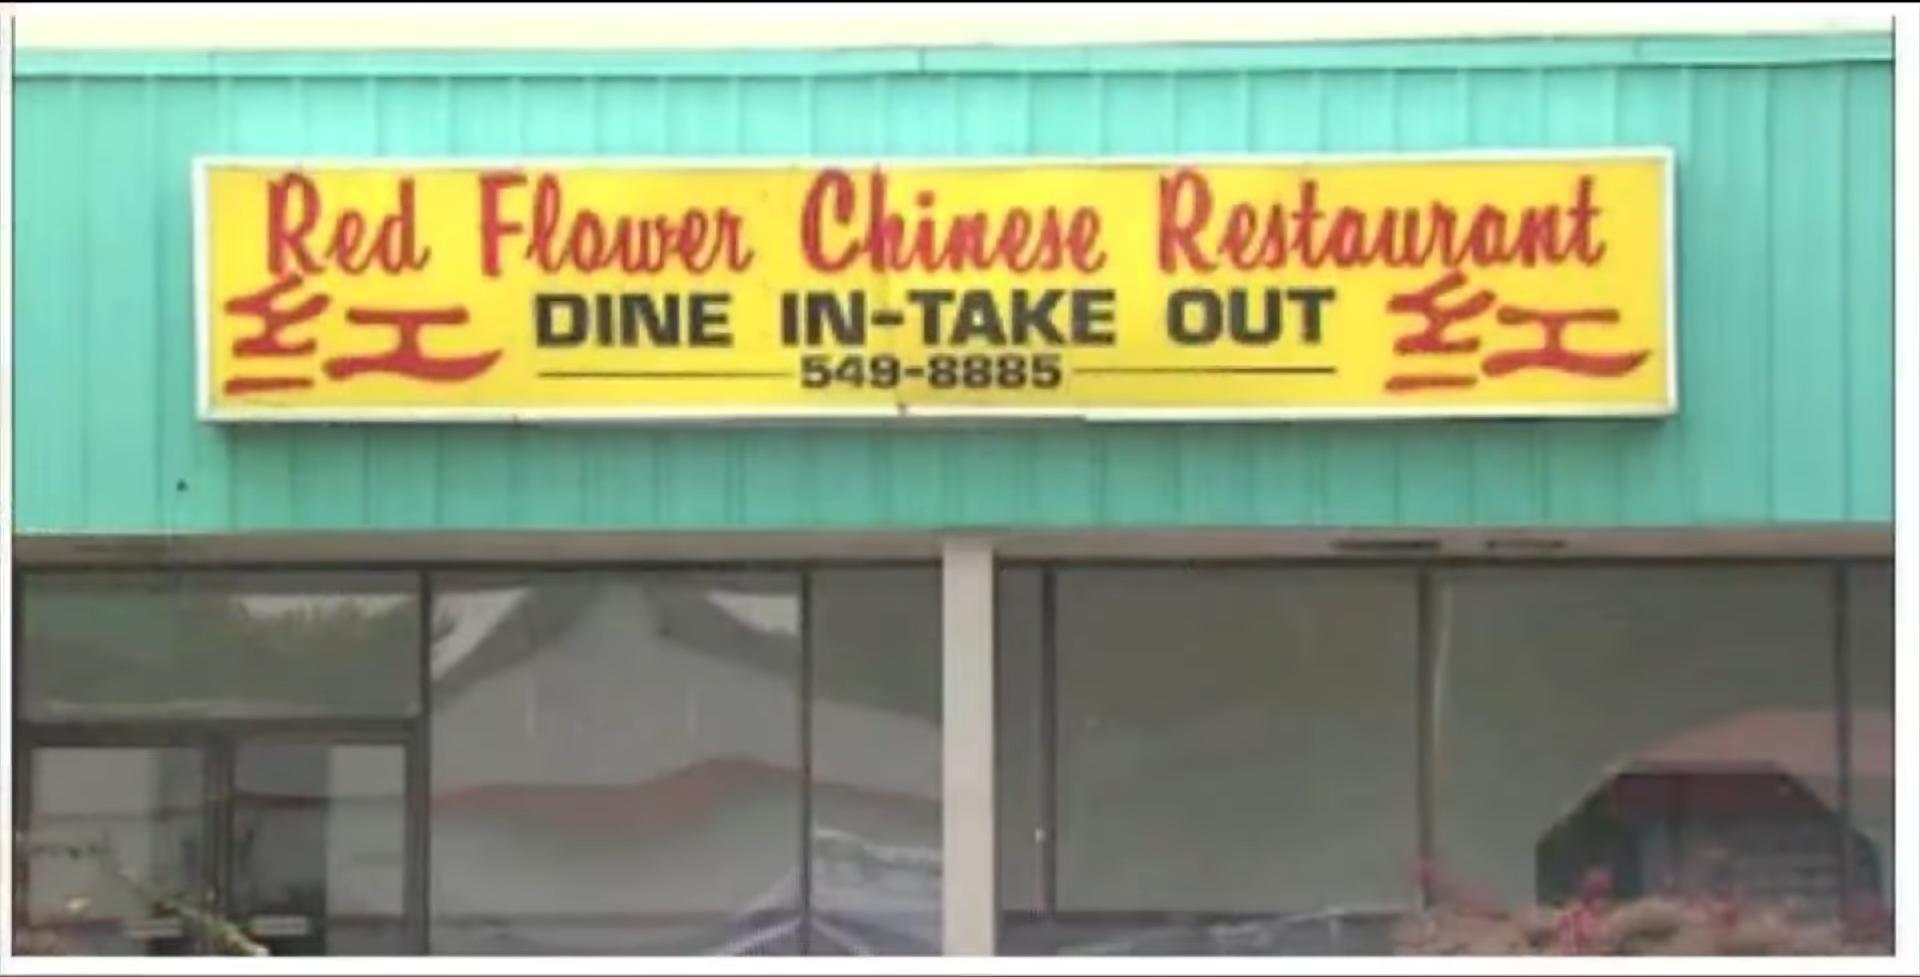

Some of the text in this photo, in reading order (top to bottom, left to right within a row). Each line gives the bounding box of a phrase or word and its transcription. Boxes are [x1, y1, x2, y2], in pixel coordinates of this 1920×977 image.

[266, 166, 1607, 278] Red Flower Chinese Restaurant
[535, 287, 1337, 347] DINE IN-TAKE OUT
[800, 353, 1062, 390] 549-8885
